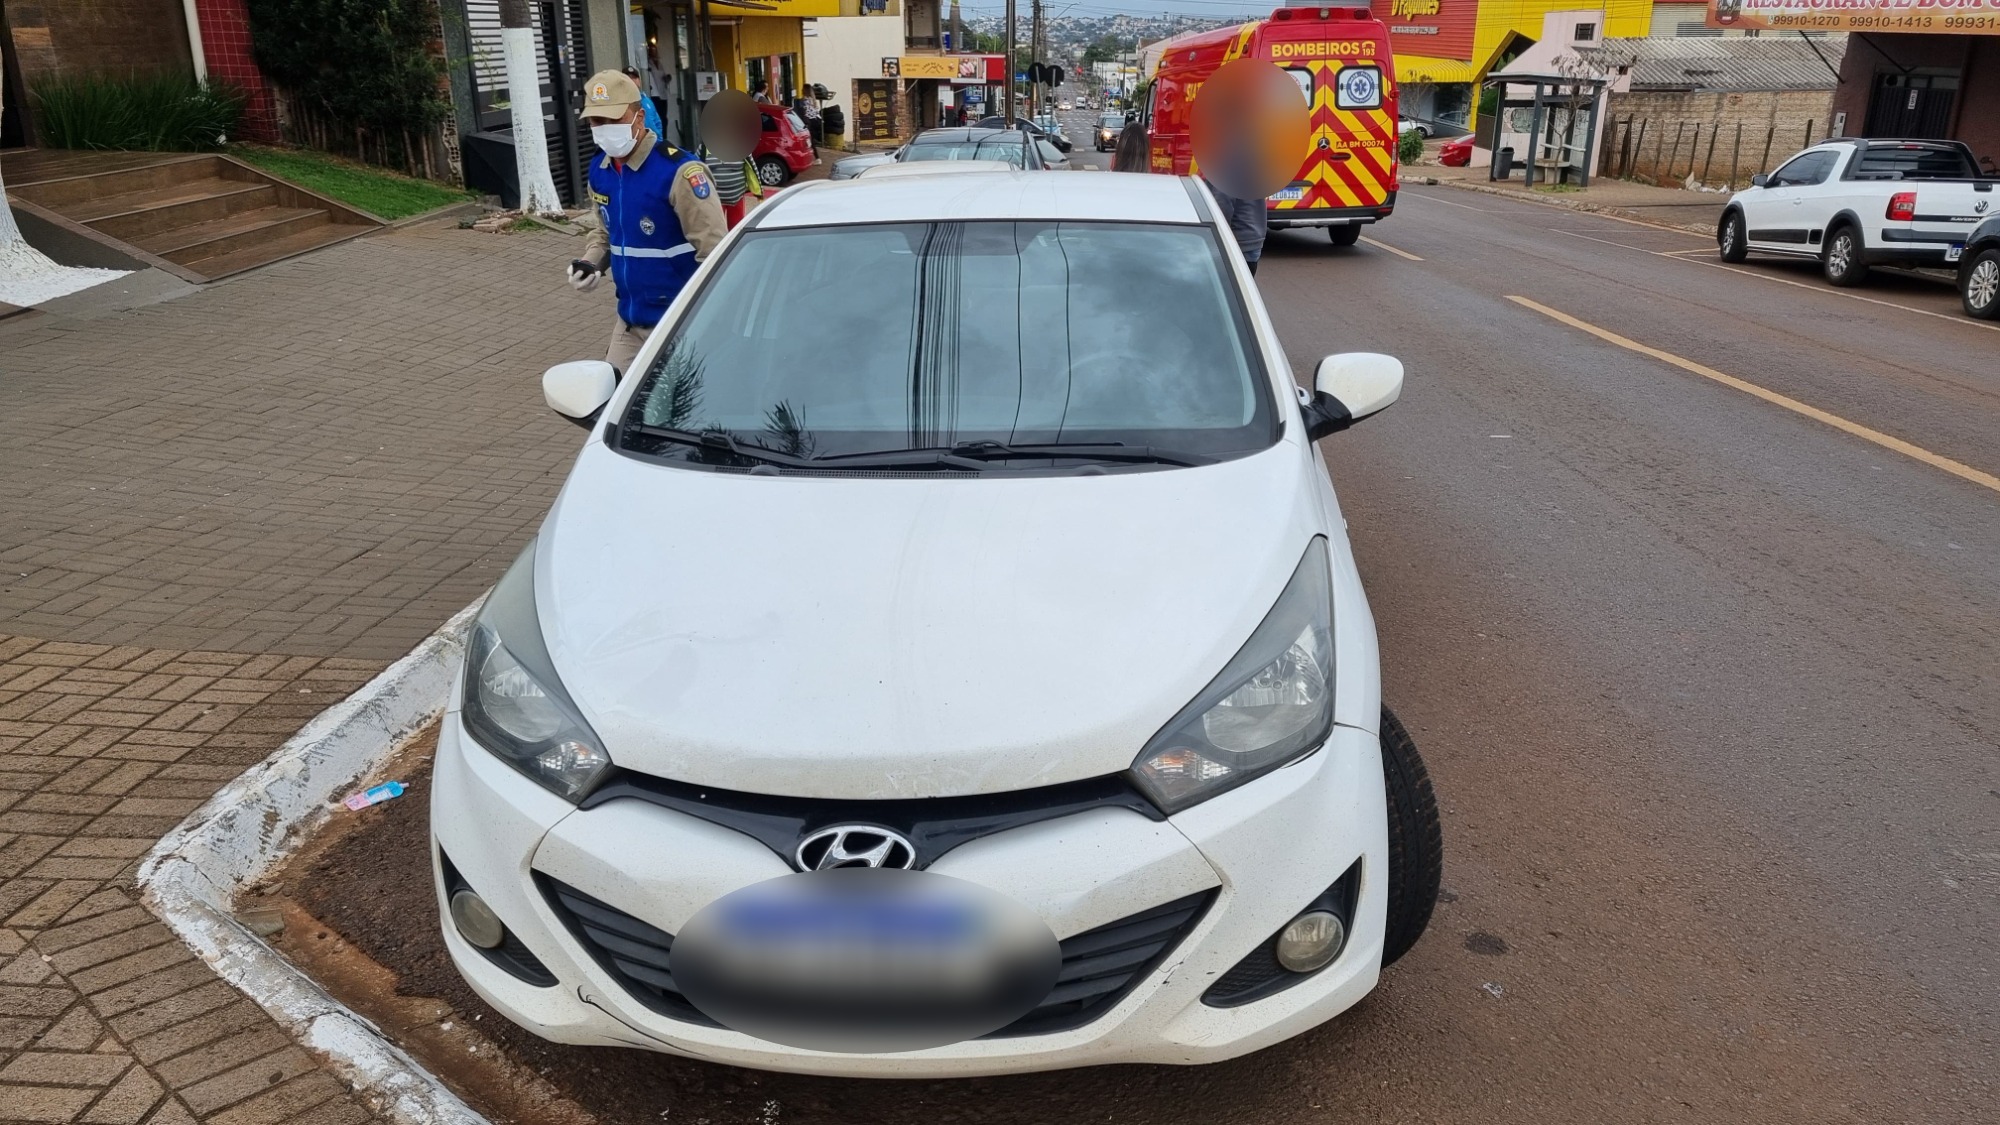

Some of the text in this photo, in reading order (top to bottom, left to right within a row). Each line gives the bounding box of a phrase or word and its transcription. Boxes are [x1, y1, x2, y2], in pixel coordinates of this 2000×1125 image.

[1773, 16, 1839, 26] 99910-1270
[1849, 16, 1932, 28] 99910-1413
[1271, 42, 1360, 58] BOMBEIROS
[1362, 48, 1376, 56] 193
